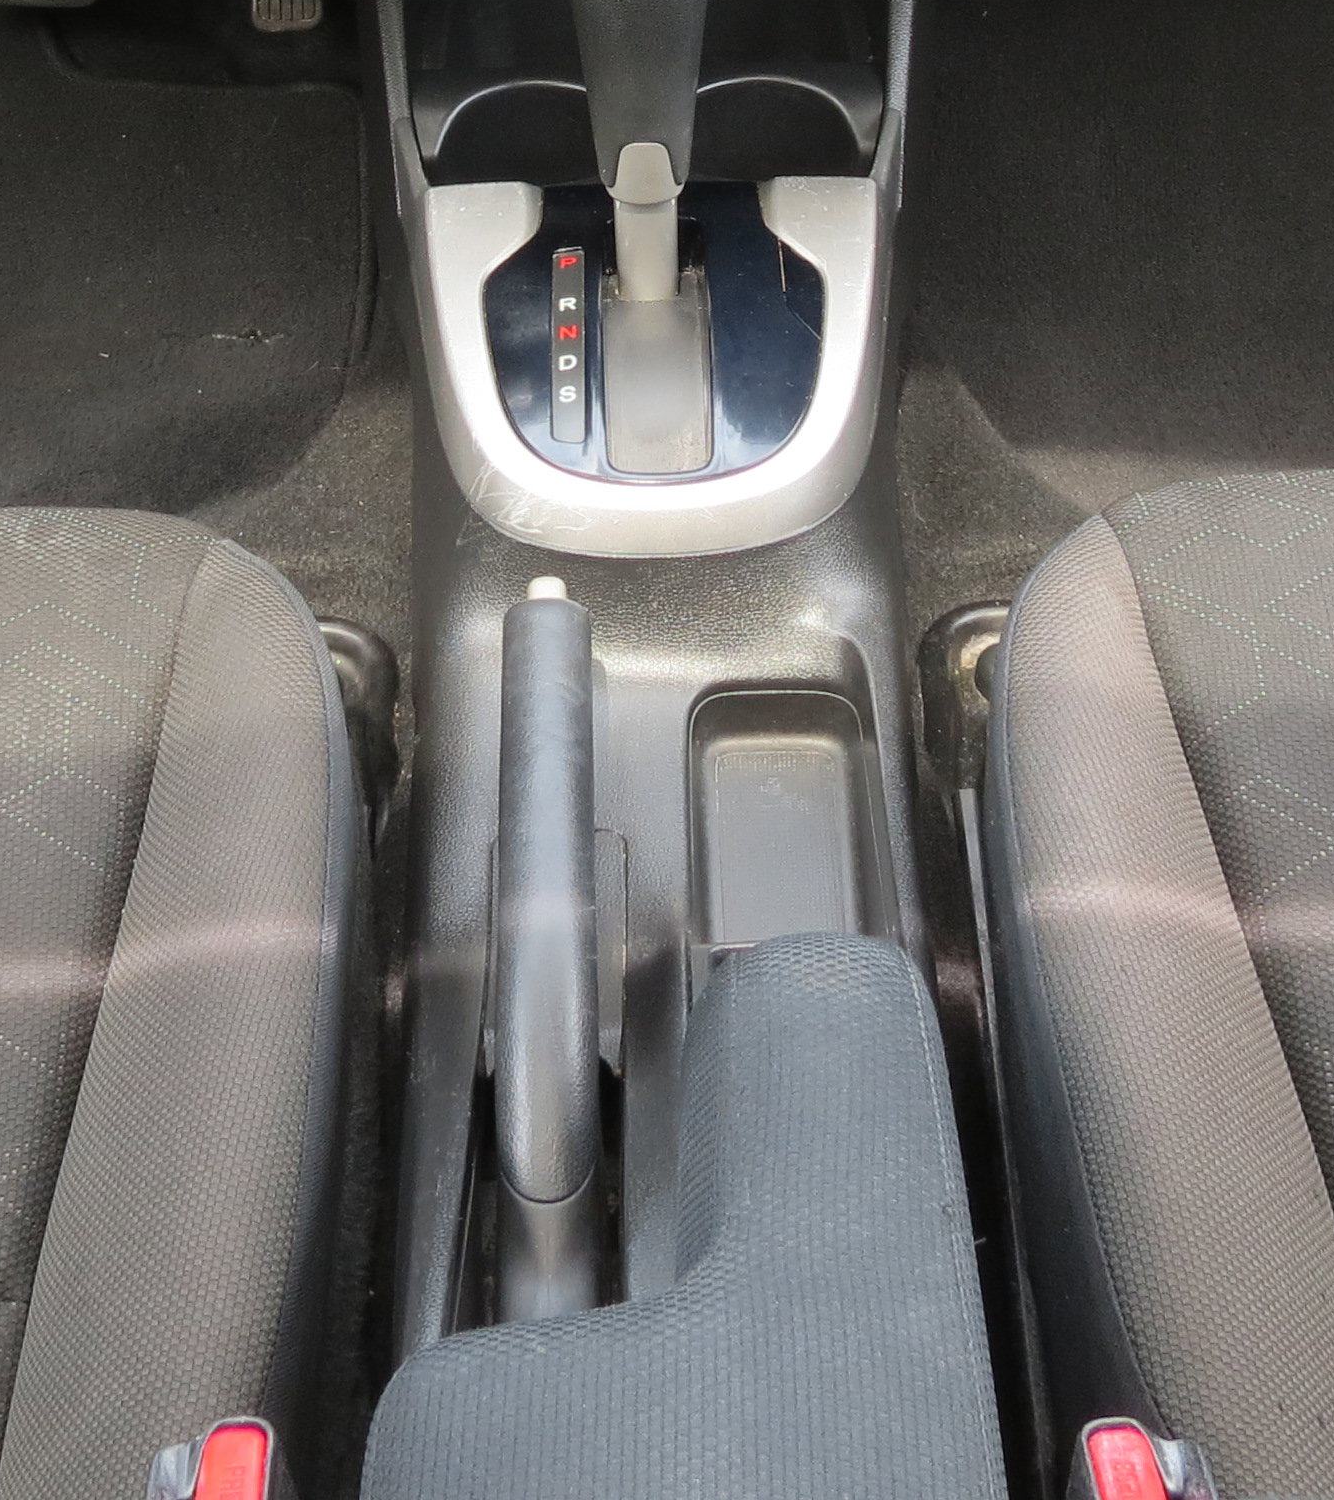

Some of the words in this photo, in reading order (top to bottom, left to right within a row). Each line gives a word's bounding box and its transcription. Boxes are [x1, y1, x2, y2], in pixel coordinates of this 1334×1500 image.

[558, 256, 577, 269] P
[558, 296, 577, 312] R
[558, 325, 578, 340] N
[558, 354, 578, 371] D
[558, 385, 577, 403] S
